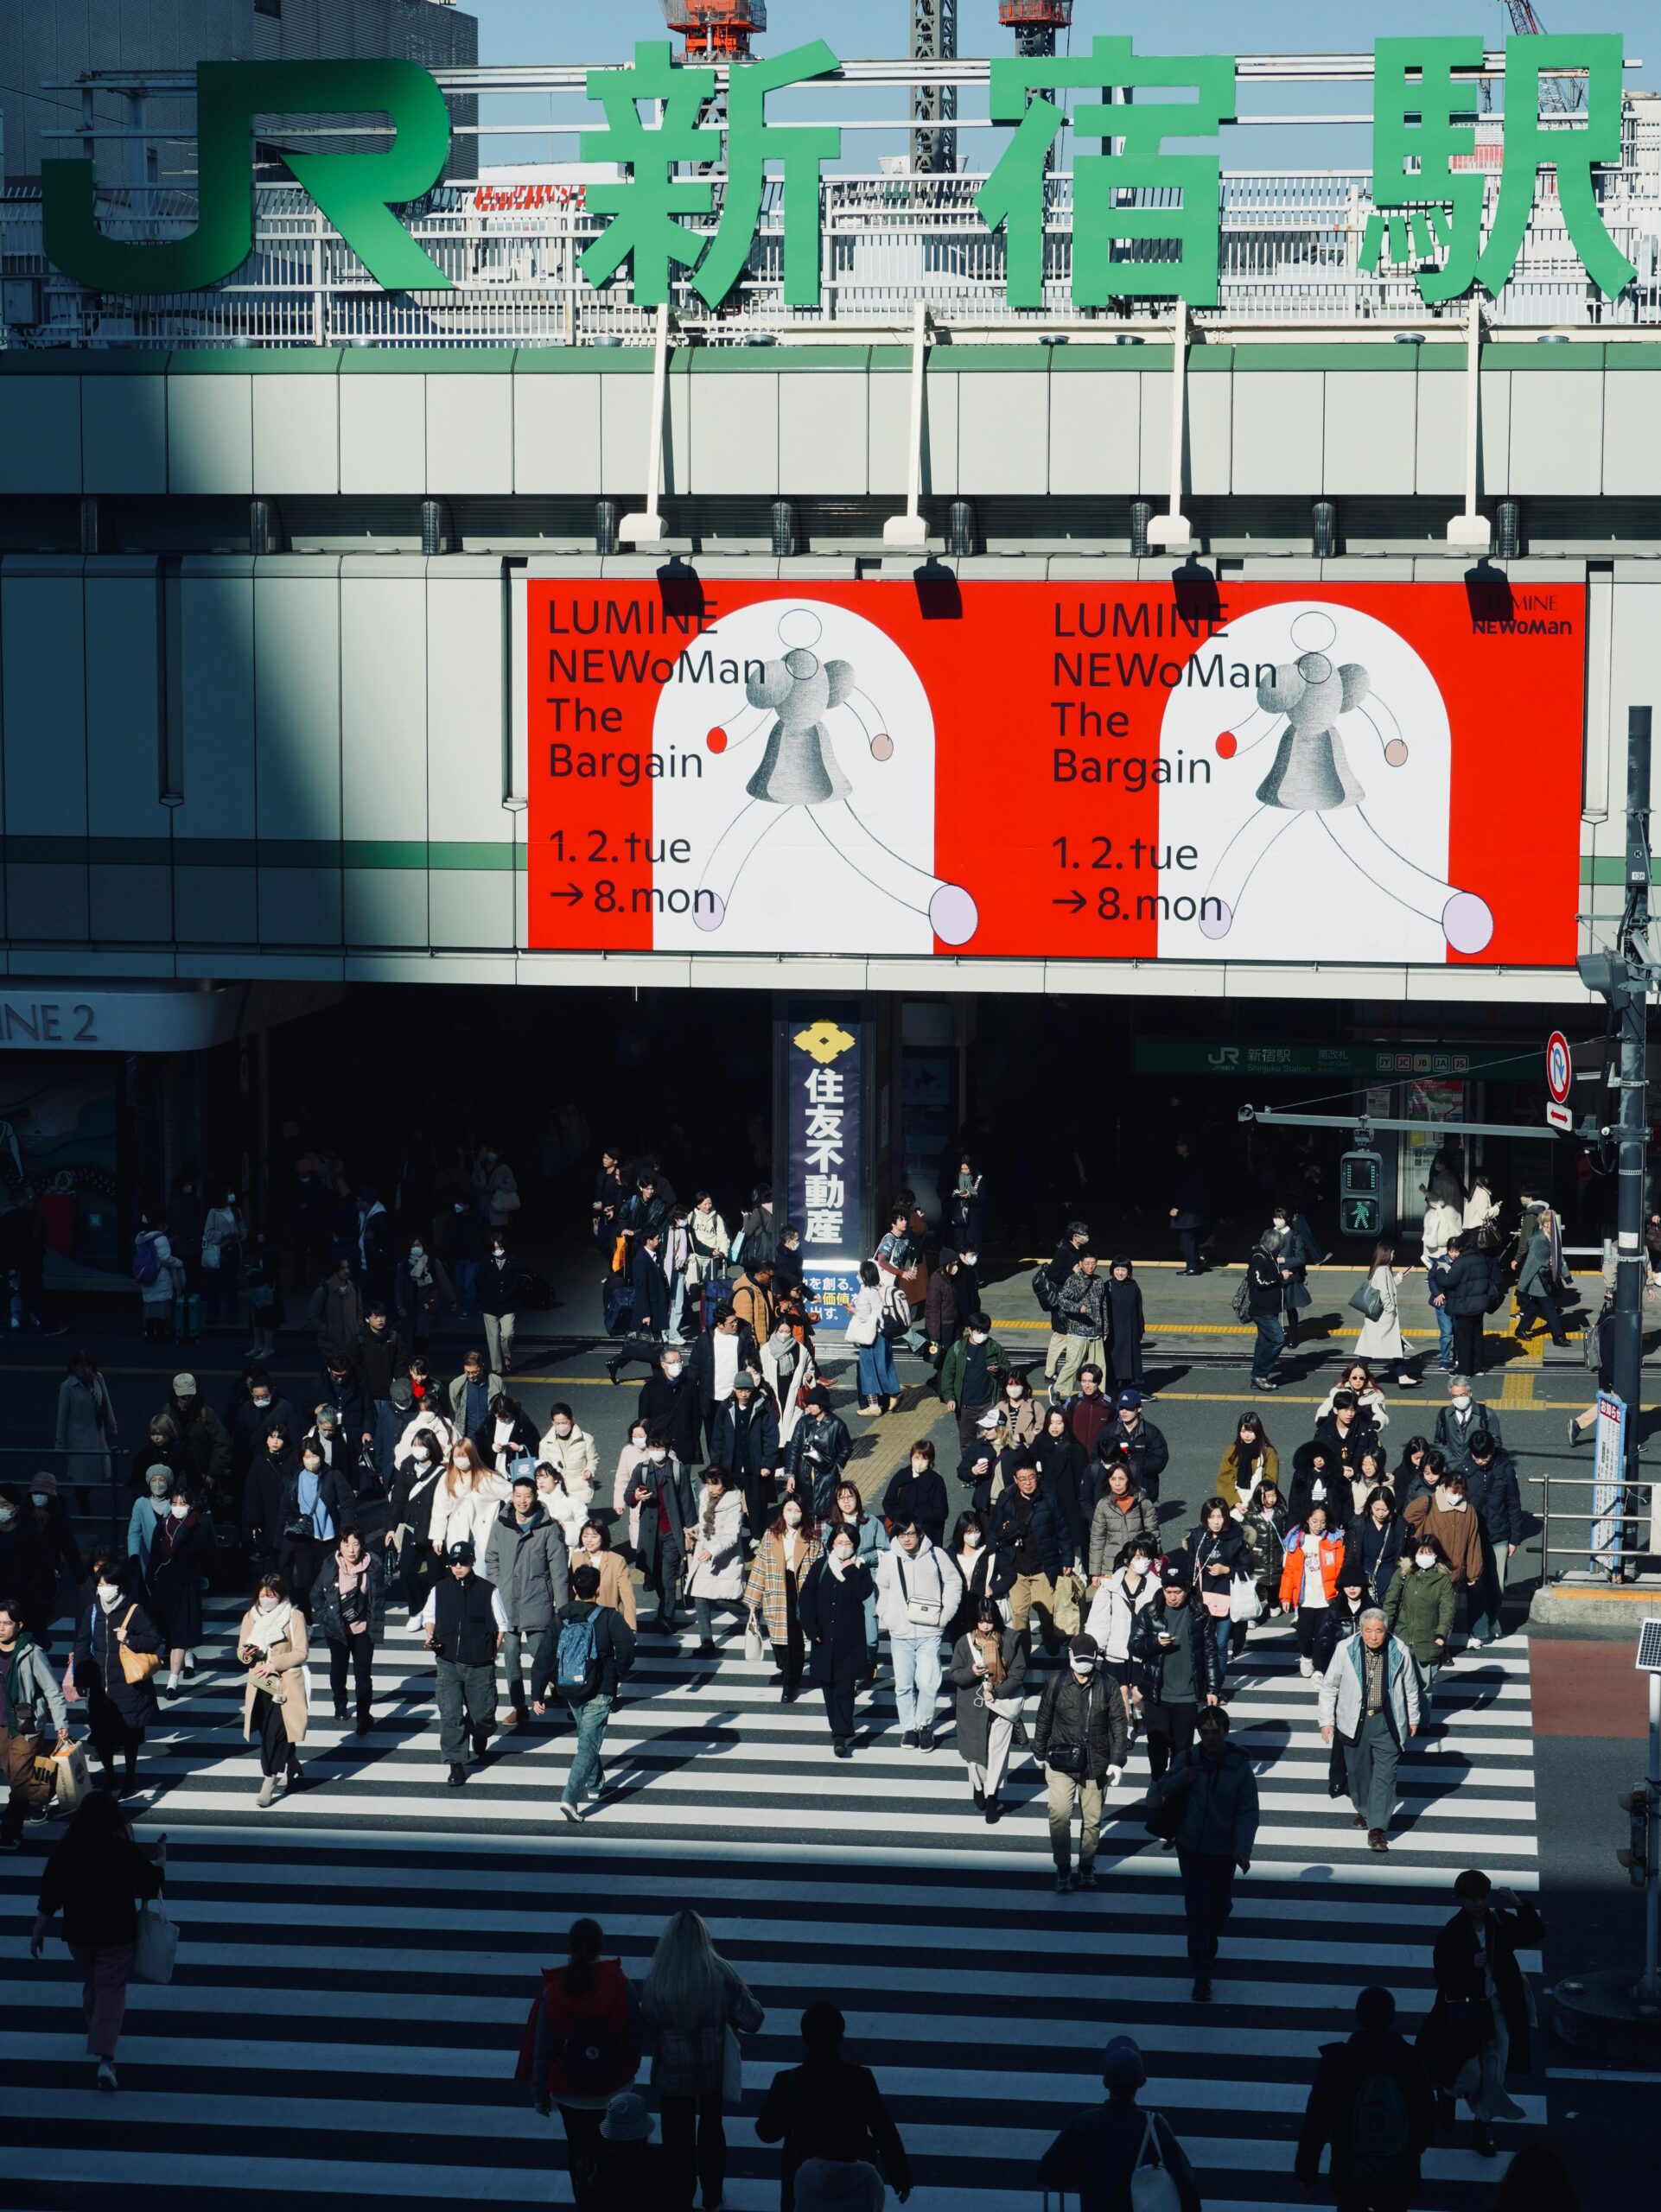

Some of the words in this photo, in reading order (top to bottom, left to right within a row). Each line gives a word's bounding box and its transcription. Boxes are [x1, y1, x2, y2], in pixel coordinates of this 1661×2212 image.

[550, 601, 718, 635] LUMINE
[1054, 603, 1230, 638] LUMINE
[1473, 620, 1572, 634] NEWoMan
[550, 649, 766, 684] NEWoMan
[1054, 652, 1277, 689] NEWoMan
[547, 697, 622, 732] The
[1052, 702, 1129, 738] The
[550, 743, 703, 786] Bargain
[1053, 748, 1211, 792] Bargain
[595, 880, 716, 913] 8.mon
[1098, 887, 1223, 921] 8.mon
[73, 1004, 98, 1042] 2
[1208, 1047, 1240, 1065] JR
[1247, 1049, 1291, 1063] 新宿駅
[804, 1068, 844, 1243] 住友不動産
